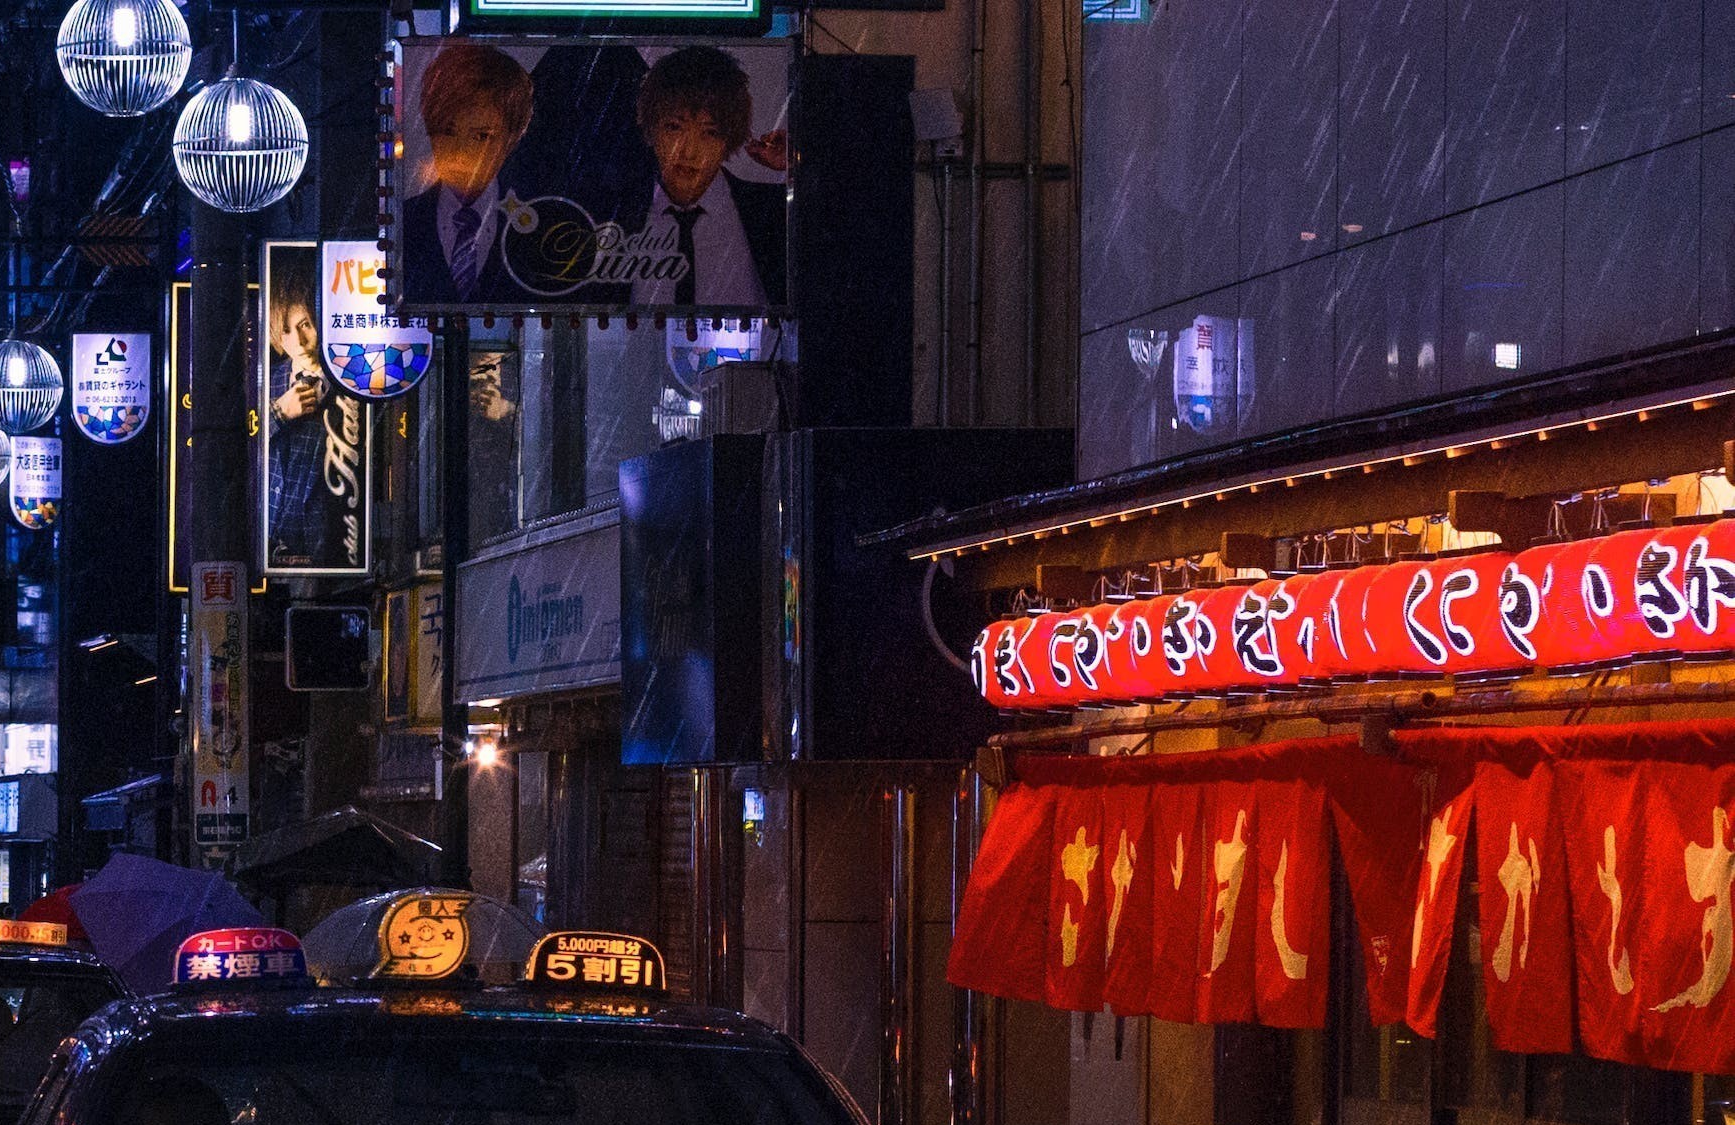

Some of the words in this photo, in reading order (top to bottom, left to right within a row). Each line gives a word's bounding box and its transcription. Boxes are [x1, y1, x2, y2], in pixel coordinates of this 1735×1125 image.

[202, 571, 235, 601] 質
[186, 951, 300, 980] 禁煙車
[546, 954, 653, 987] 5割引
